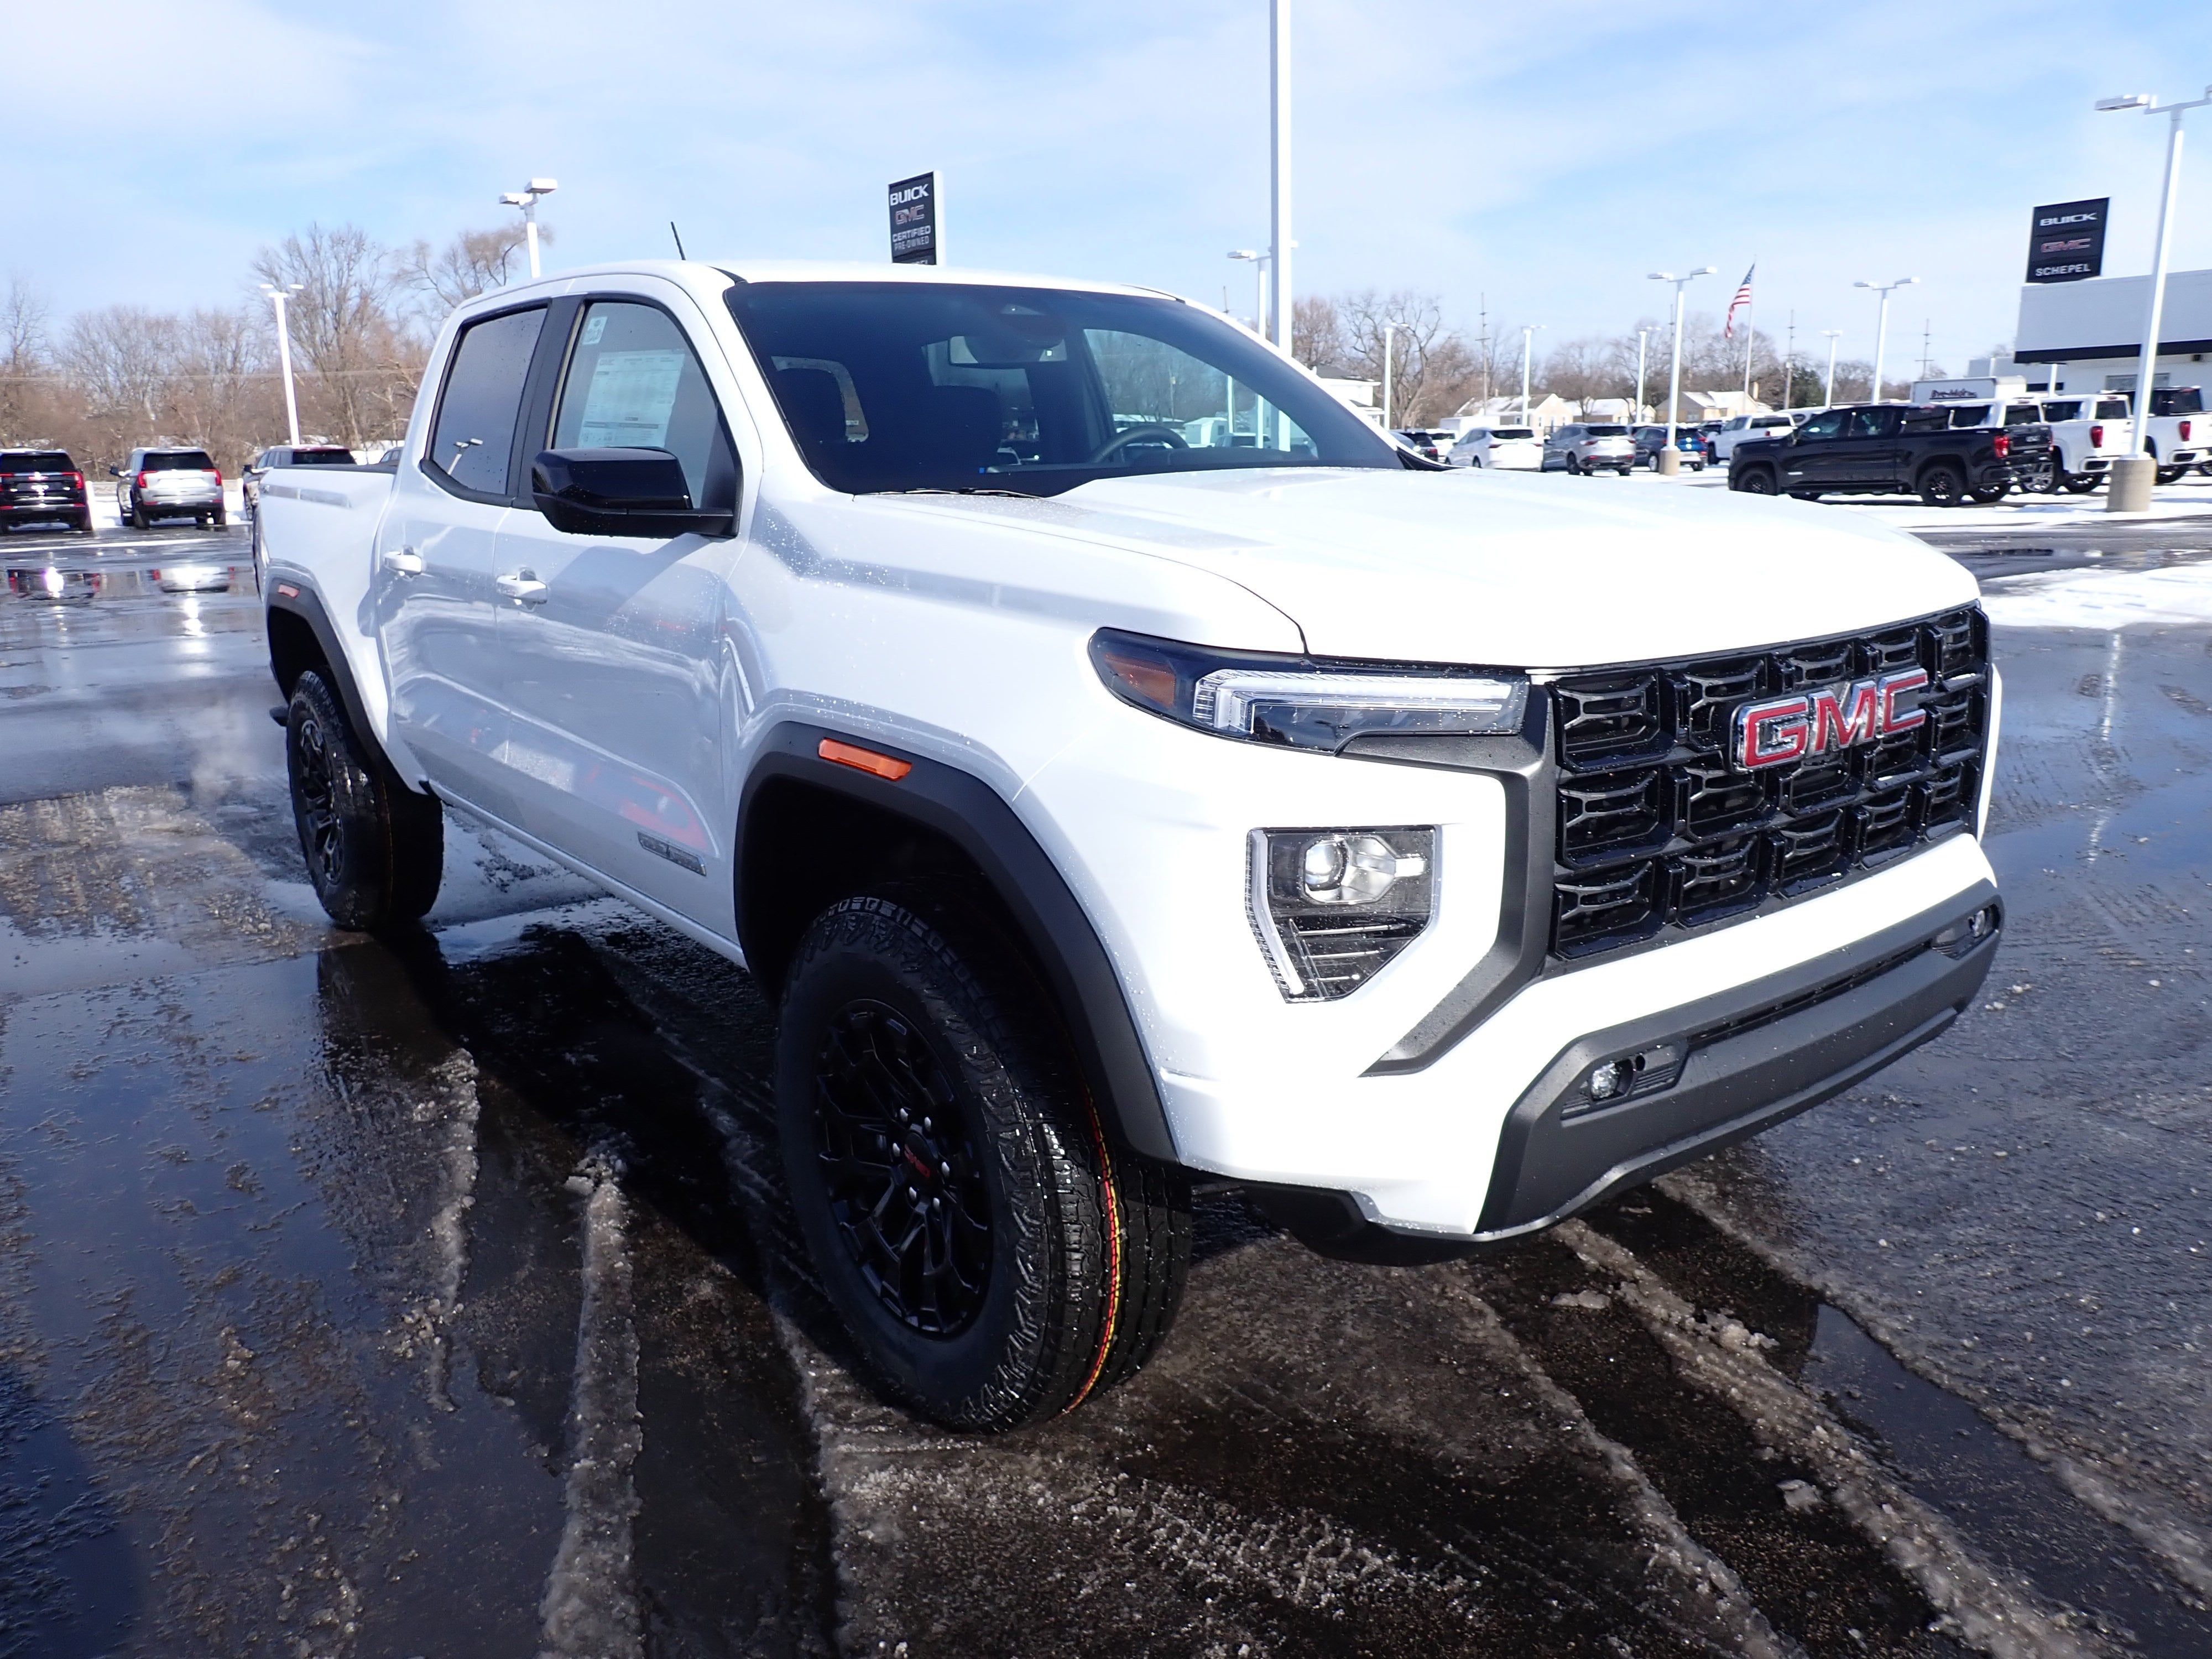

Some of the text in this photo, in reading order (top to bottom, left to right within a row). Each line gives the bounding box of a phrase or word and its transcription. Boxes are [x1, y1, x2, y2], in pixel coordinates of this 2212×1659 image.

[890, 184, 929, 206] BUICK
[895, 204, 925, 225] GMC
[2039, 213, 2098, 226] BUICK
[893, 225, 931, 242] CERTIFIED
[894, 236, 930, 251] PRE-OWNED
[2041, 238, 2092, 253] GMC
[2035, 263, 2091, 276] SCHEPEL
[1736, 668, 1928, 769] GMC
